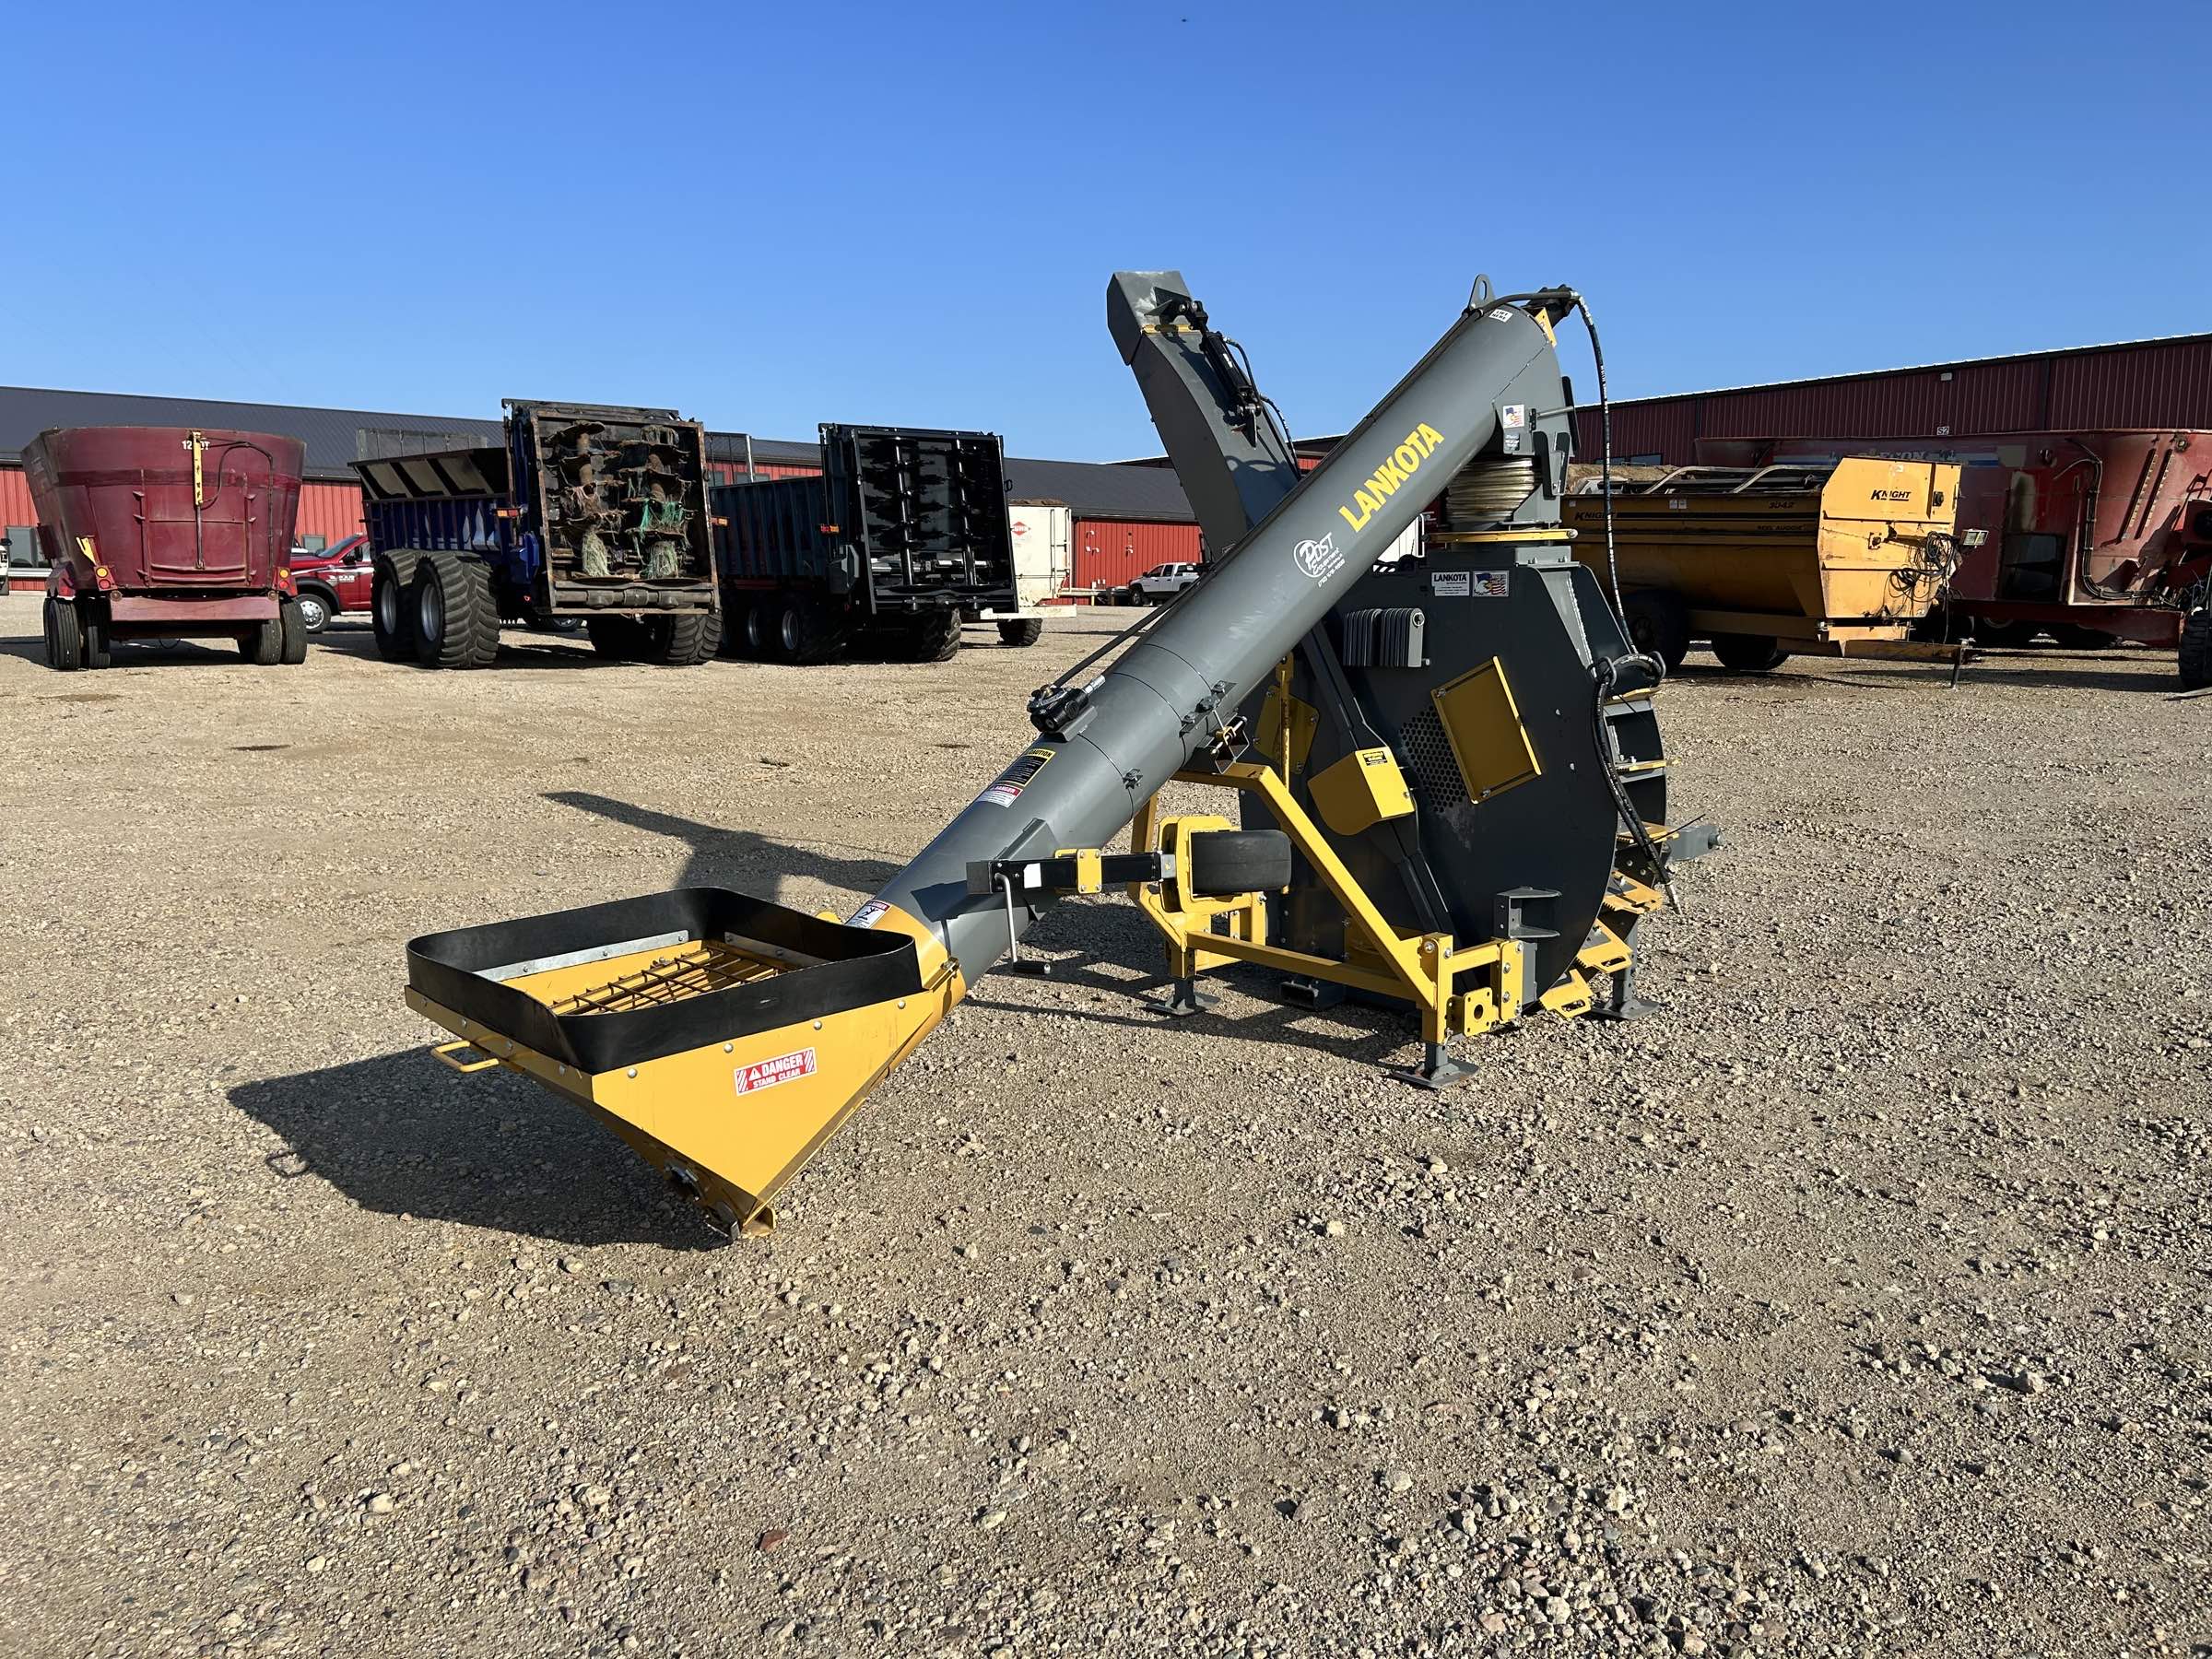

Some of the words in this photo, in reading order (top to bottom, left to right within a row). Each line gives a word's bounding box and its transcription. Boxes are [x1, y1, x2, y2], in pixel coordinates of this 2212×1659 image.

[1338, 423, 1445, 532] LANKOTA
[1870, 489, 1912, 500] KNIGHT
[1433, 573, 1467, 582] LANKOTA
[761, 1053, 804, 1077] DANGER
[752, 1075, 777, 1088] STAND
[778, 1067, 801, 1081] CLEAR
